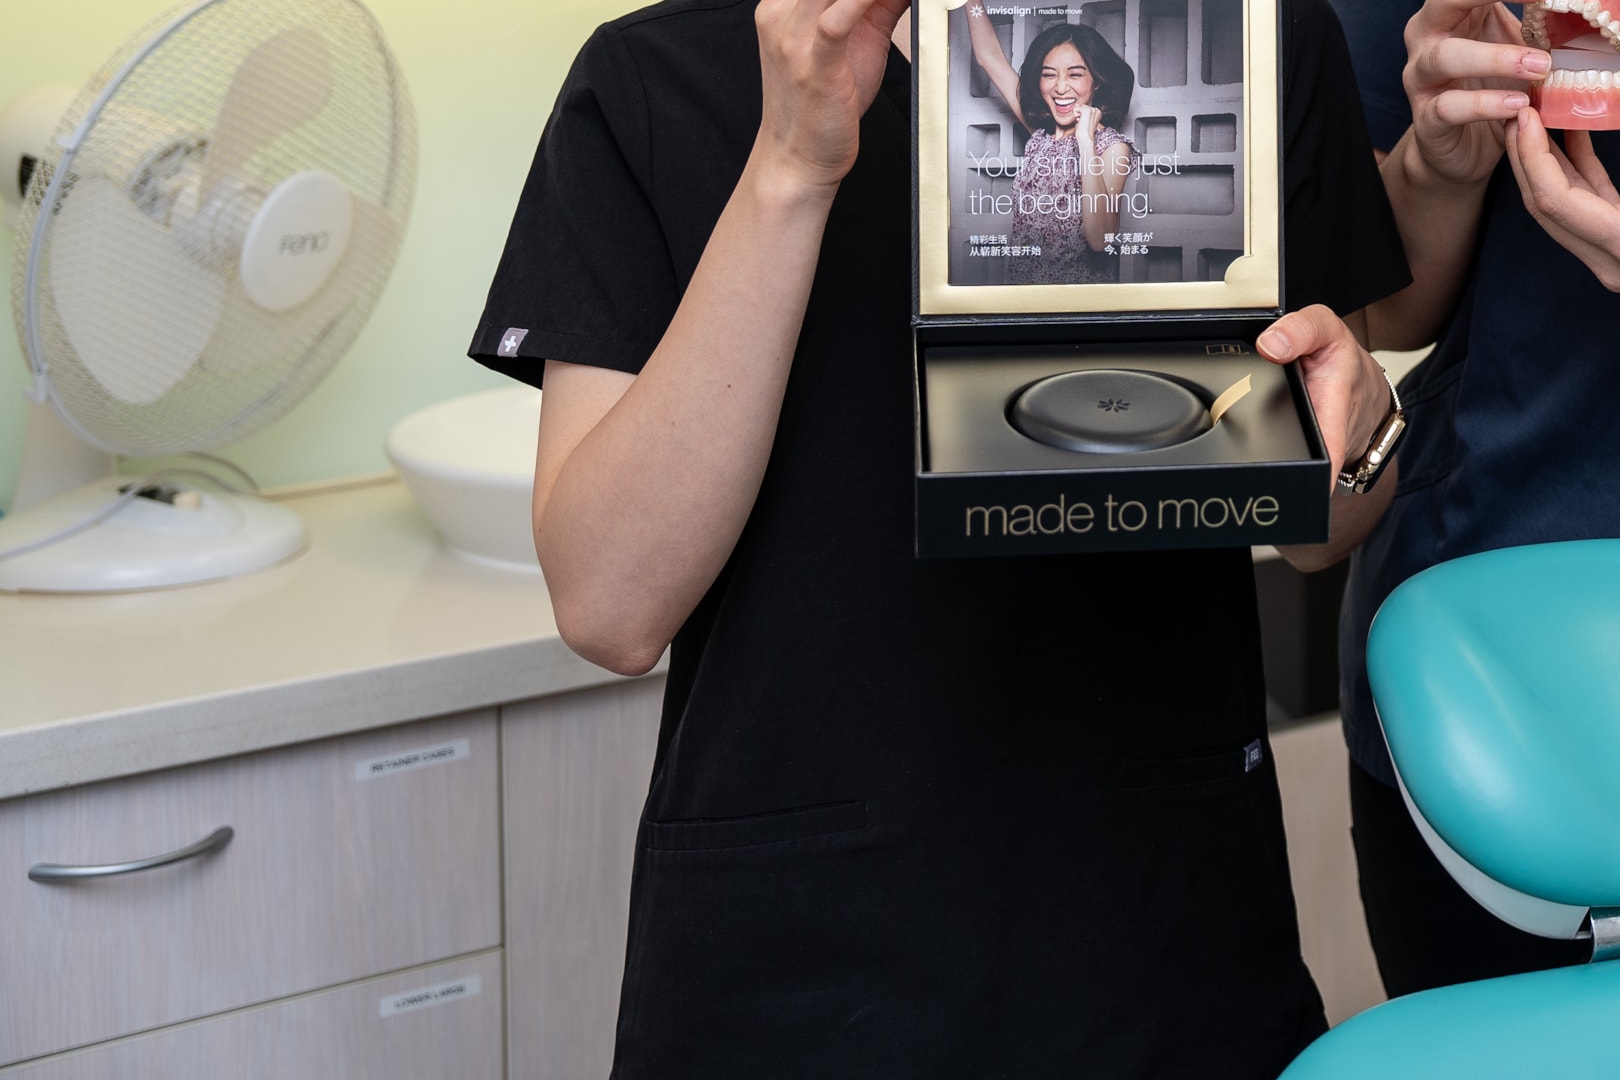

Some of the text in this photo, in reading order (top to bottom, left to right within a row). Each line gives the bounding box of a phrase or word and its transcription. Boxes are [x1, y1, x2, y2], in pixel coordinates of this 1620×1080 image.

[987, 5, 1031, 17] invisalign
[968, 150, 1181, 180] Your smile is just
[969, 187, 1153, 220] the beginning.
[969, 234, 1008, 245] 精彩生活
[965, 494, 1280, 537] made to move
